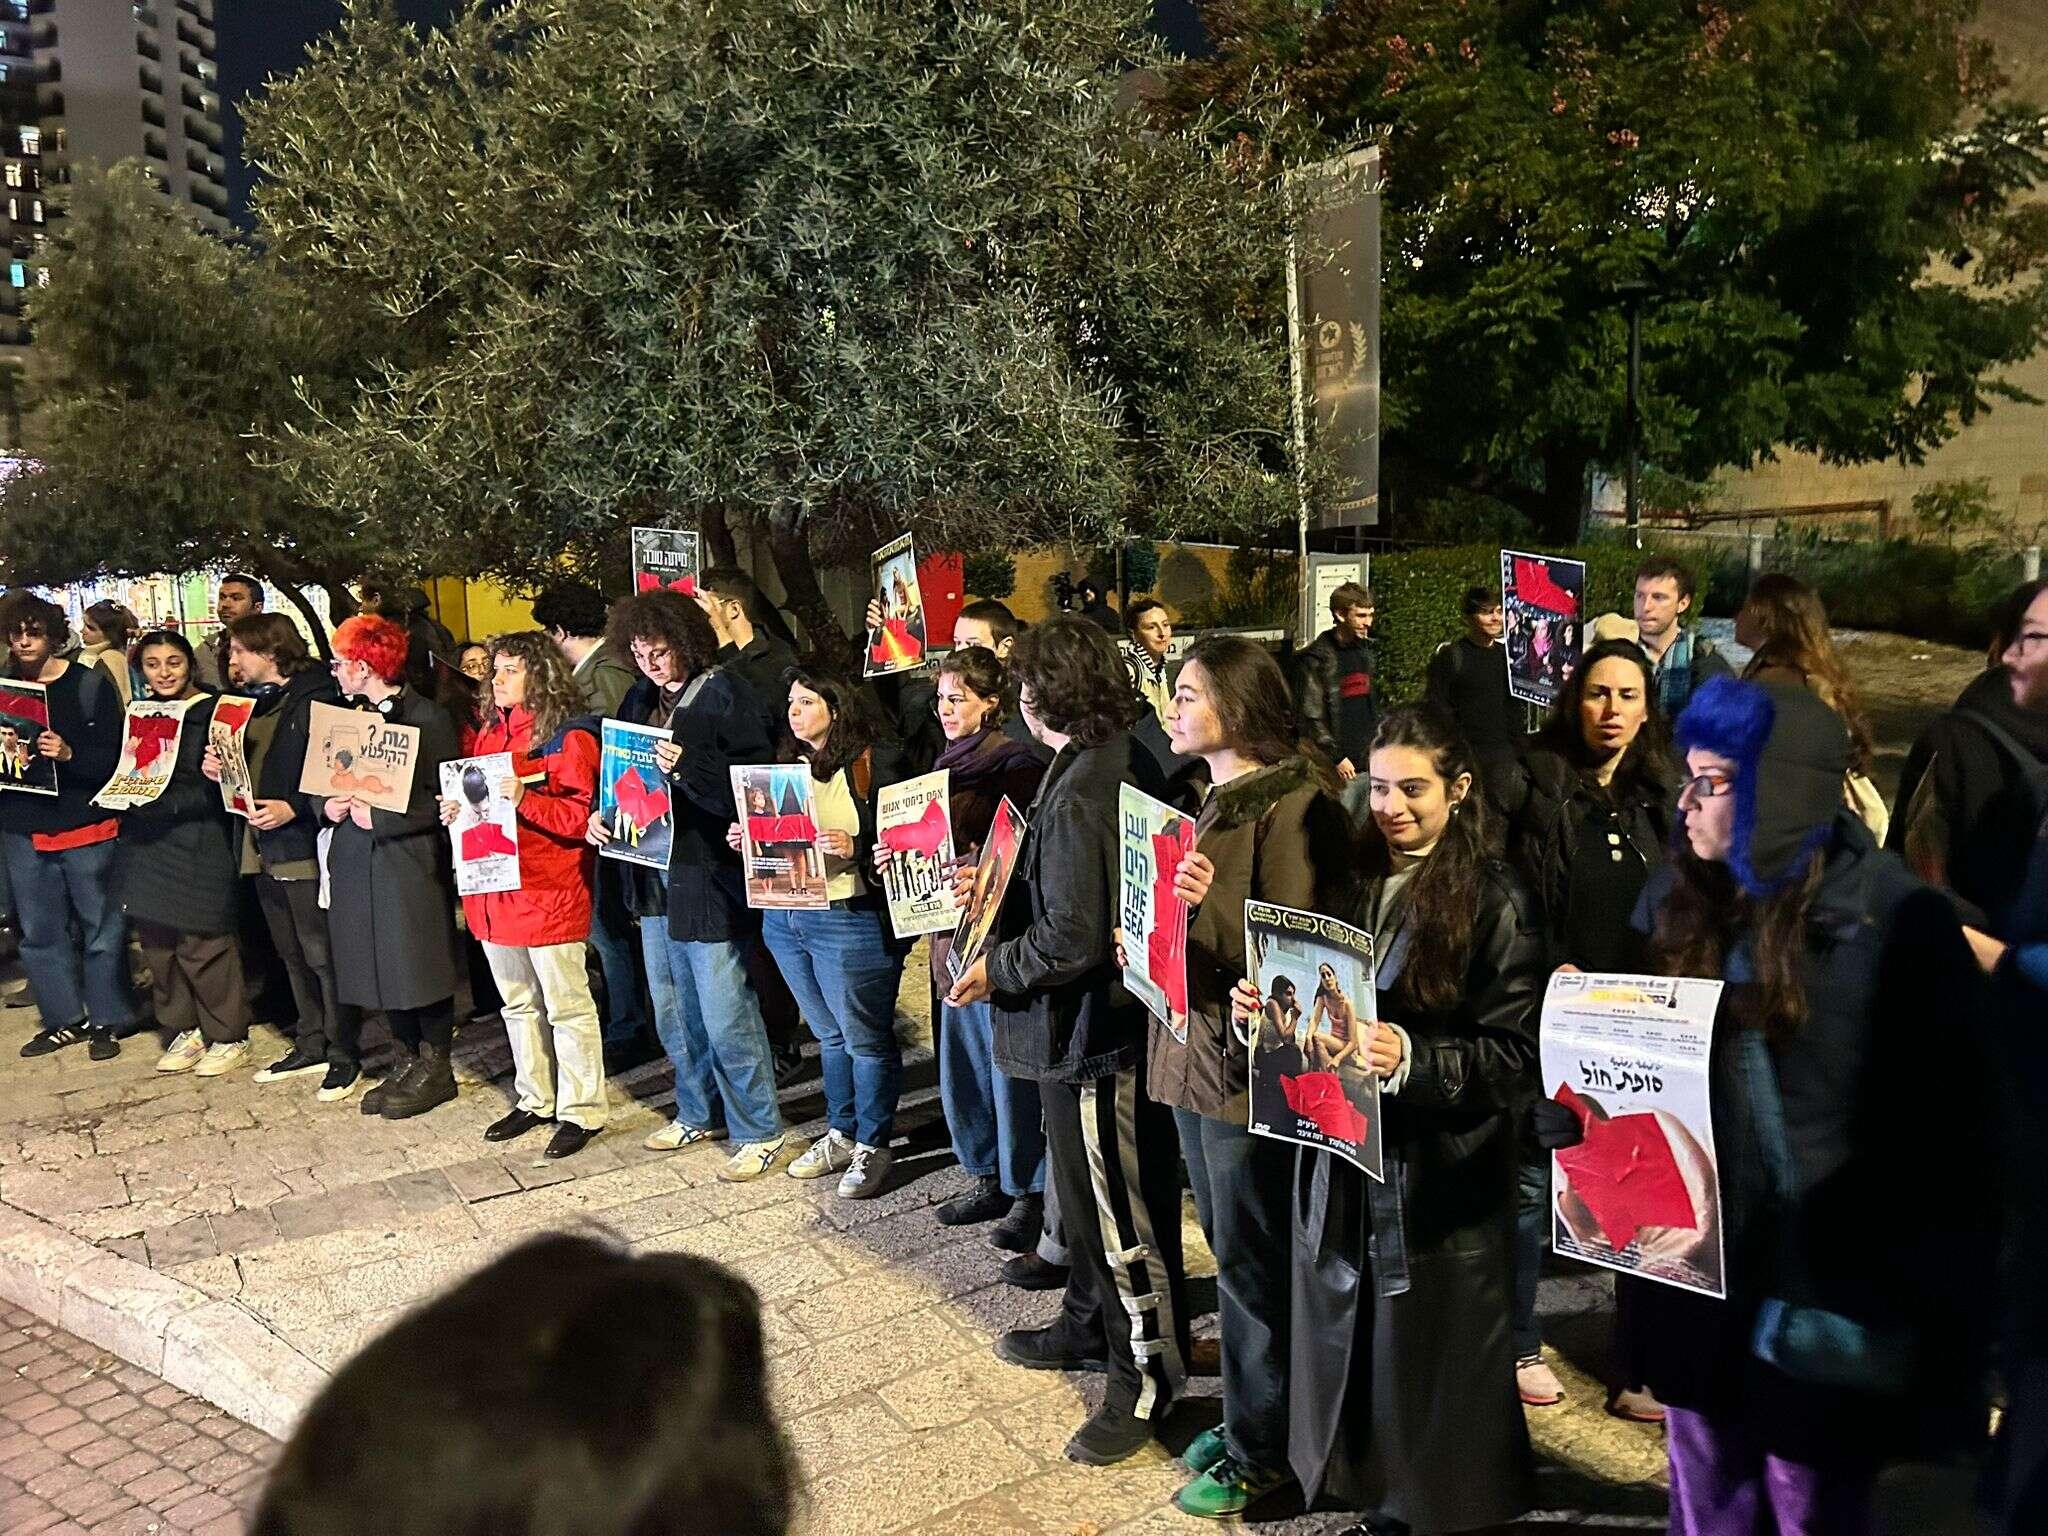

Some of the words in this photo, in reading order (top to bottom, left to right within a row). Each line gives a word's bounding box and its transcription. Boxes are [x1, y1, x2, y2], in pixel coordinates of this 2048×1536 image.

[882, 800, 900, 814] אנוש
[902, 794, 923, 808] ביחסי
[926, 788, 943, 801] אפס
[1124, 844, 1148, 886] הים
[1125, 879, 1148, 916] THE
[1124, 908, 1144, 944] SEA
[1579, 1059, 1612, 1086] חול
[1615, 1070, 1663, 1093] סופת
